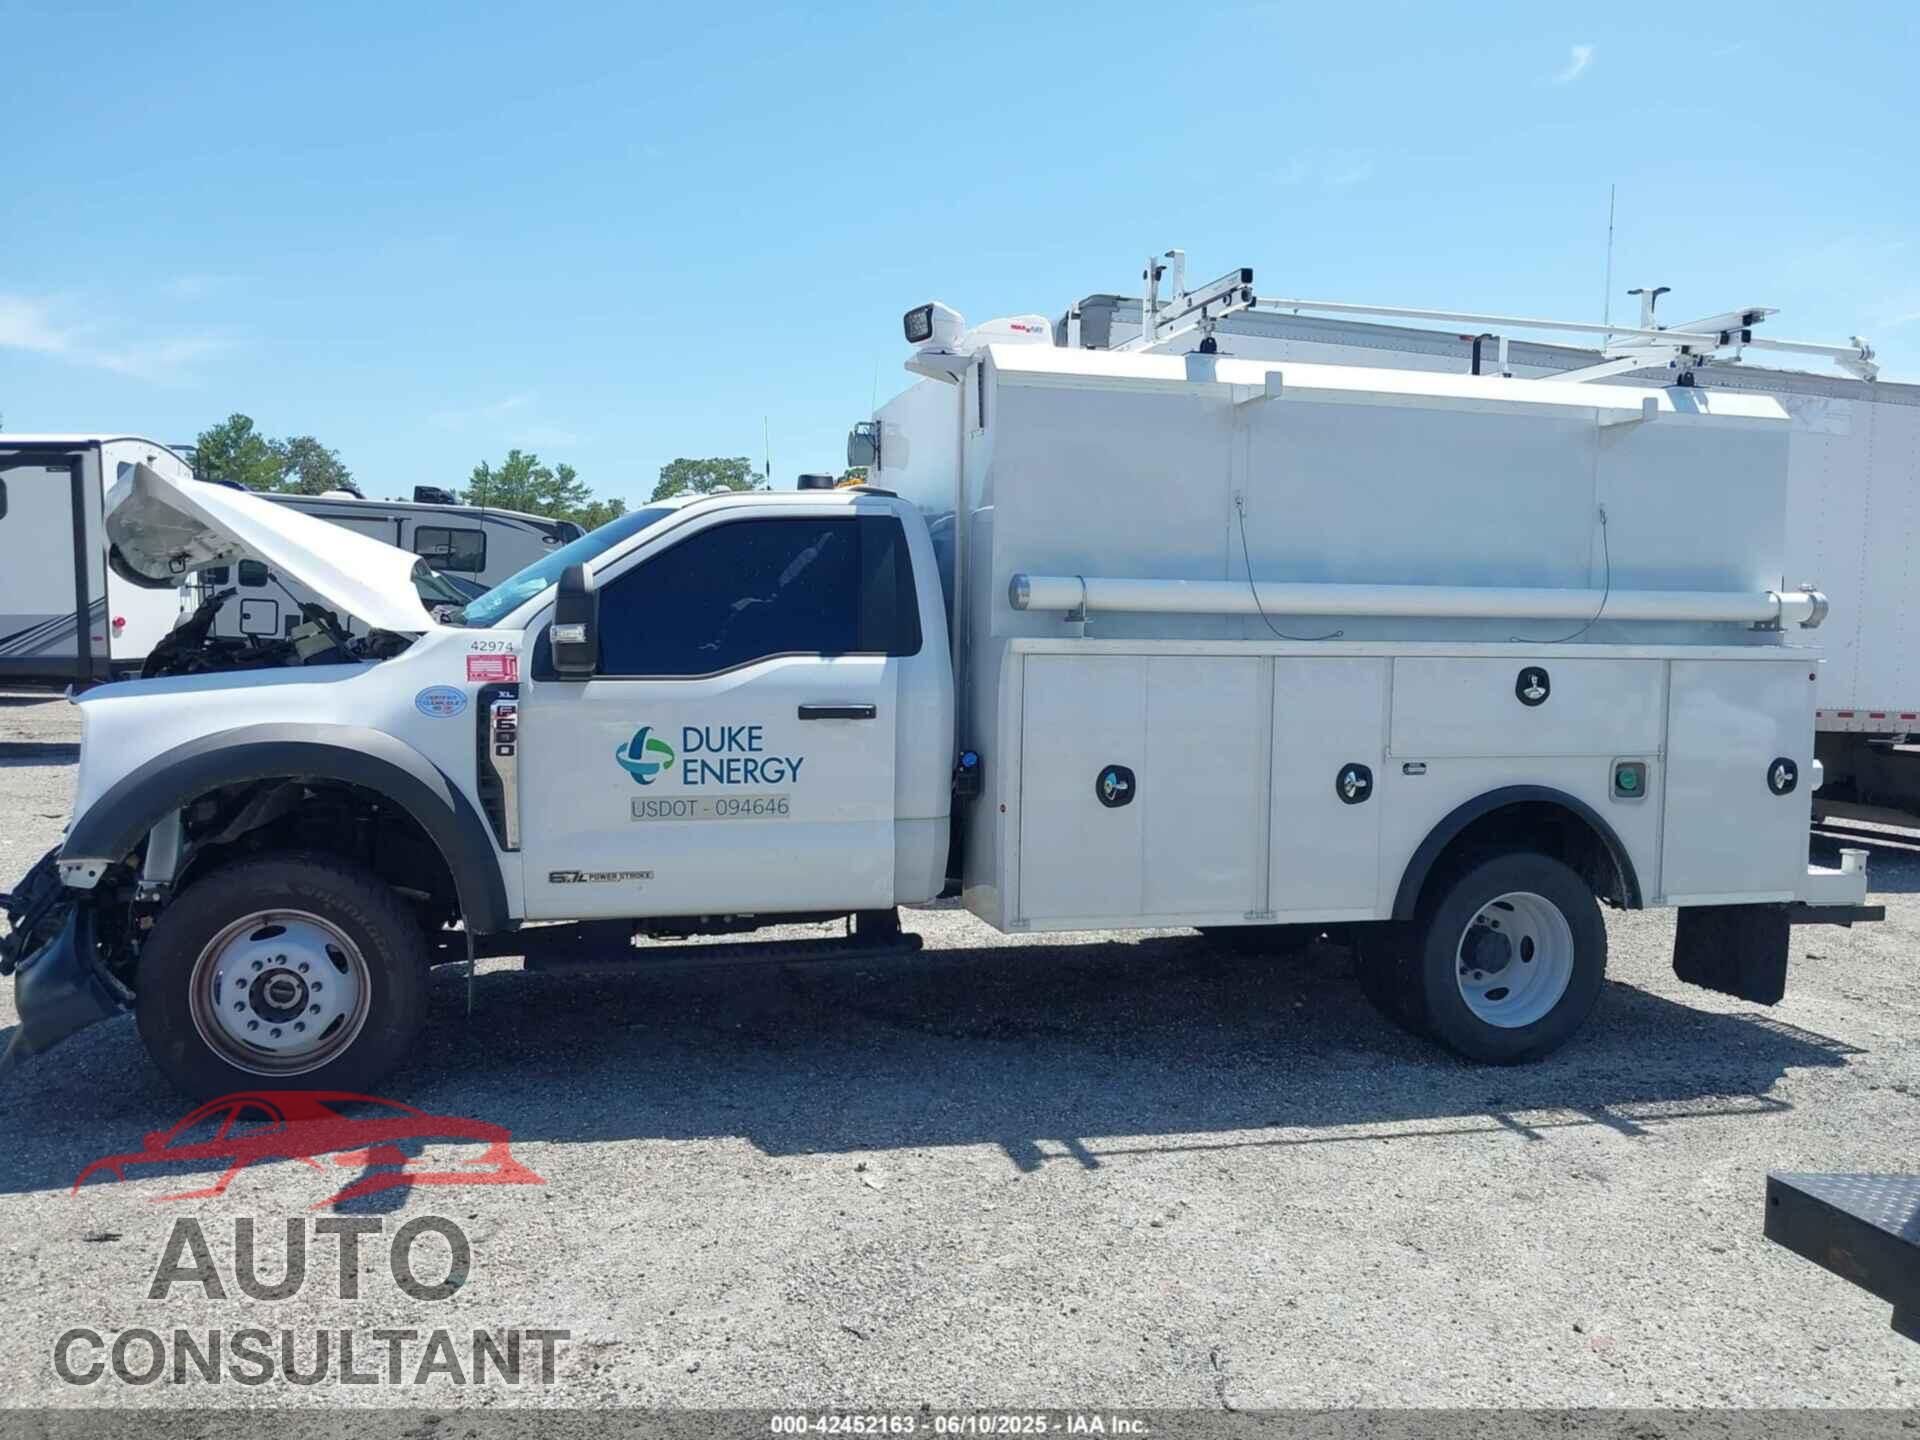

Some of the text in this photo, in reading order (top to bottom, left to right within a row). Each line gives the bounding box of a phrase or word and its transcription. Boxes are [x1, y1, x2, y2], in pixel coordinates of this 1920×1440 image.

[470, 640, 513, 652] 42974
[682, 725, 764, 753] DUKE
[682, 756, 804, 785] ENERGY
[631, 799, 698, 818] USDOT
[715, 797, 790, 816] 094646
